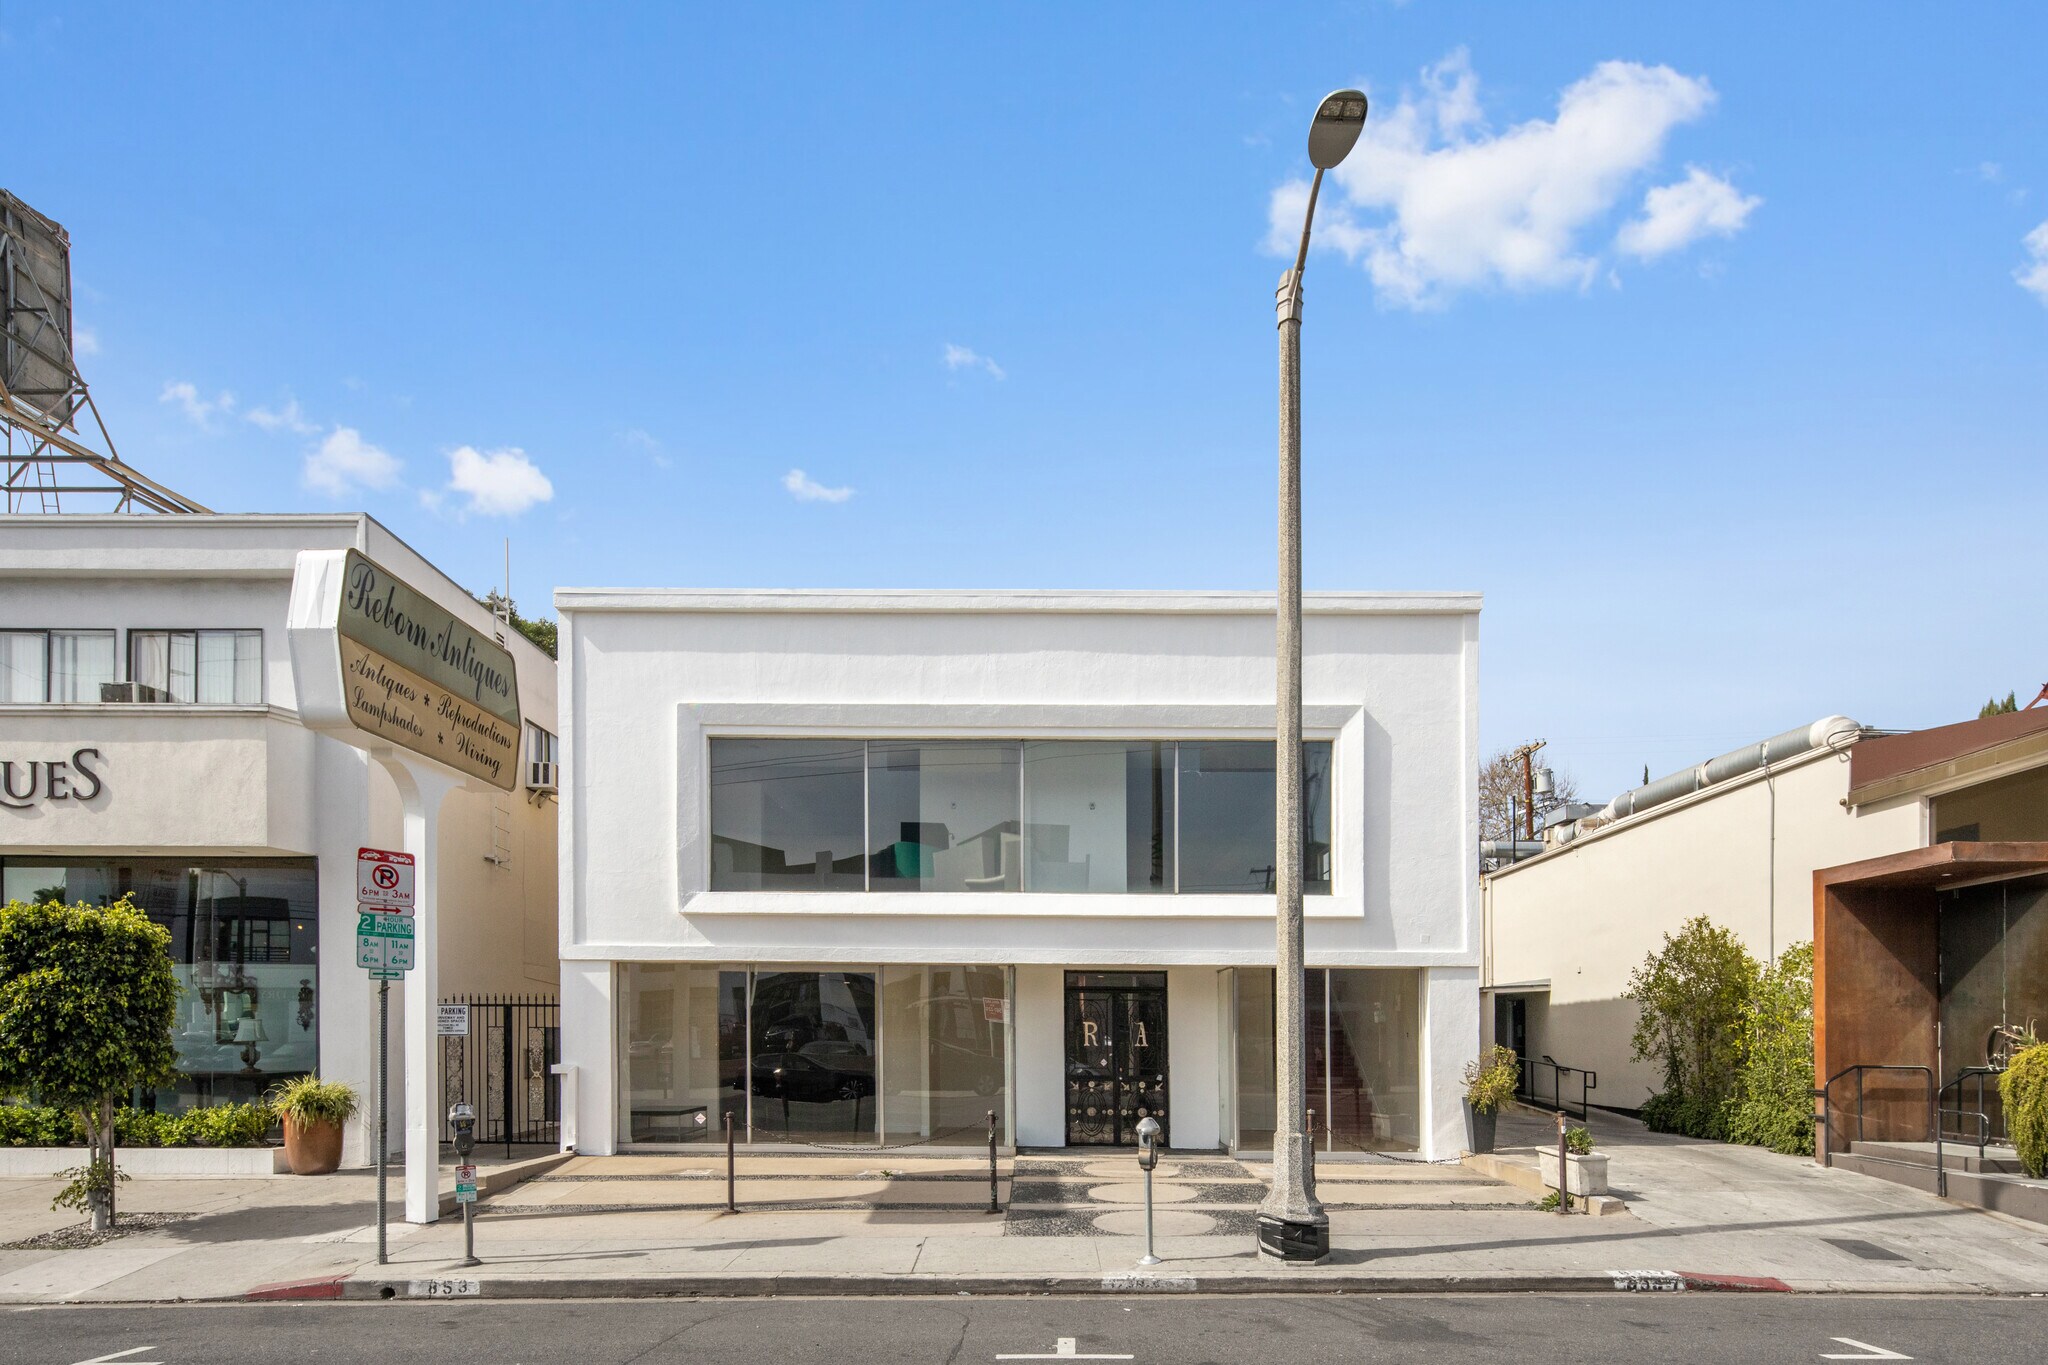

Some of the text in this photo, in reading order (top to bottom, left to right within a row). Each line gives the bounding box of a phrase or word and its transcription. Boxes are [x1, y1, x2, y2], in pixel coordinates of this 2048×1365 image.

[348, 562, 511, 701] Reborn Antiques
[350, 653, 512, 749] Antiques Reproductions
[352, 685, 503, 778] Lampshades Wiring
[0, 748, 101, 809] UES
[361, 915, 371, 930] 2
[376, 921, 412, 934] PARKING
[441, 1007, 466, 1015] PARKING
[1083, 1021, 1149, 1047] R A
[428, 1280, 467, 1295] 853
